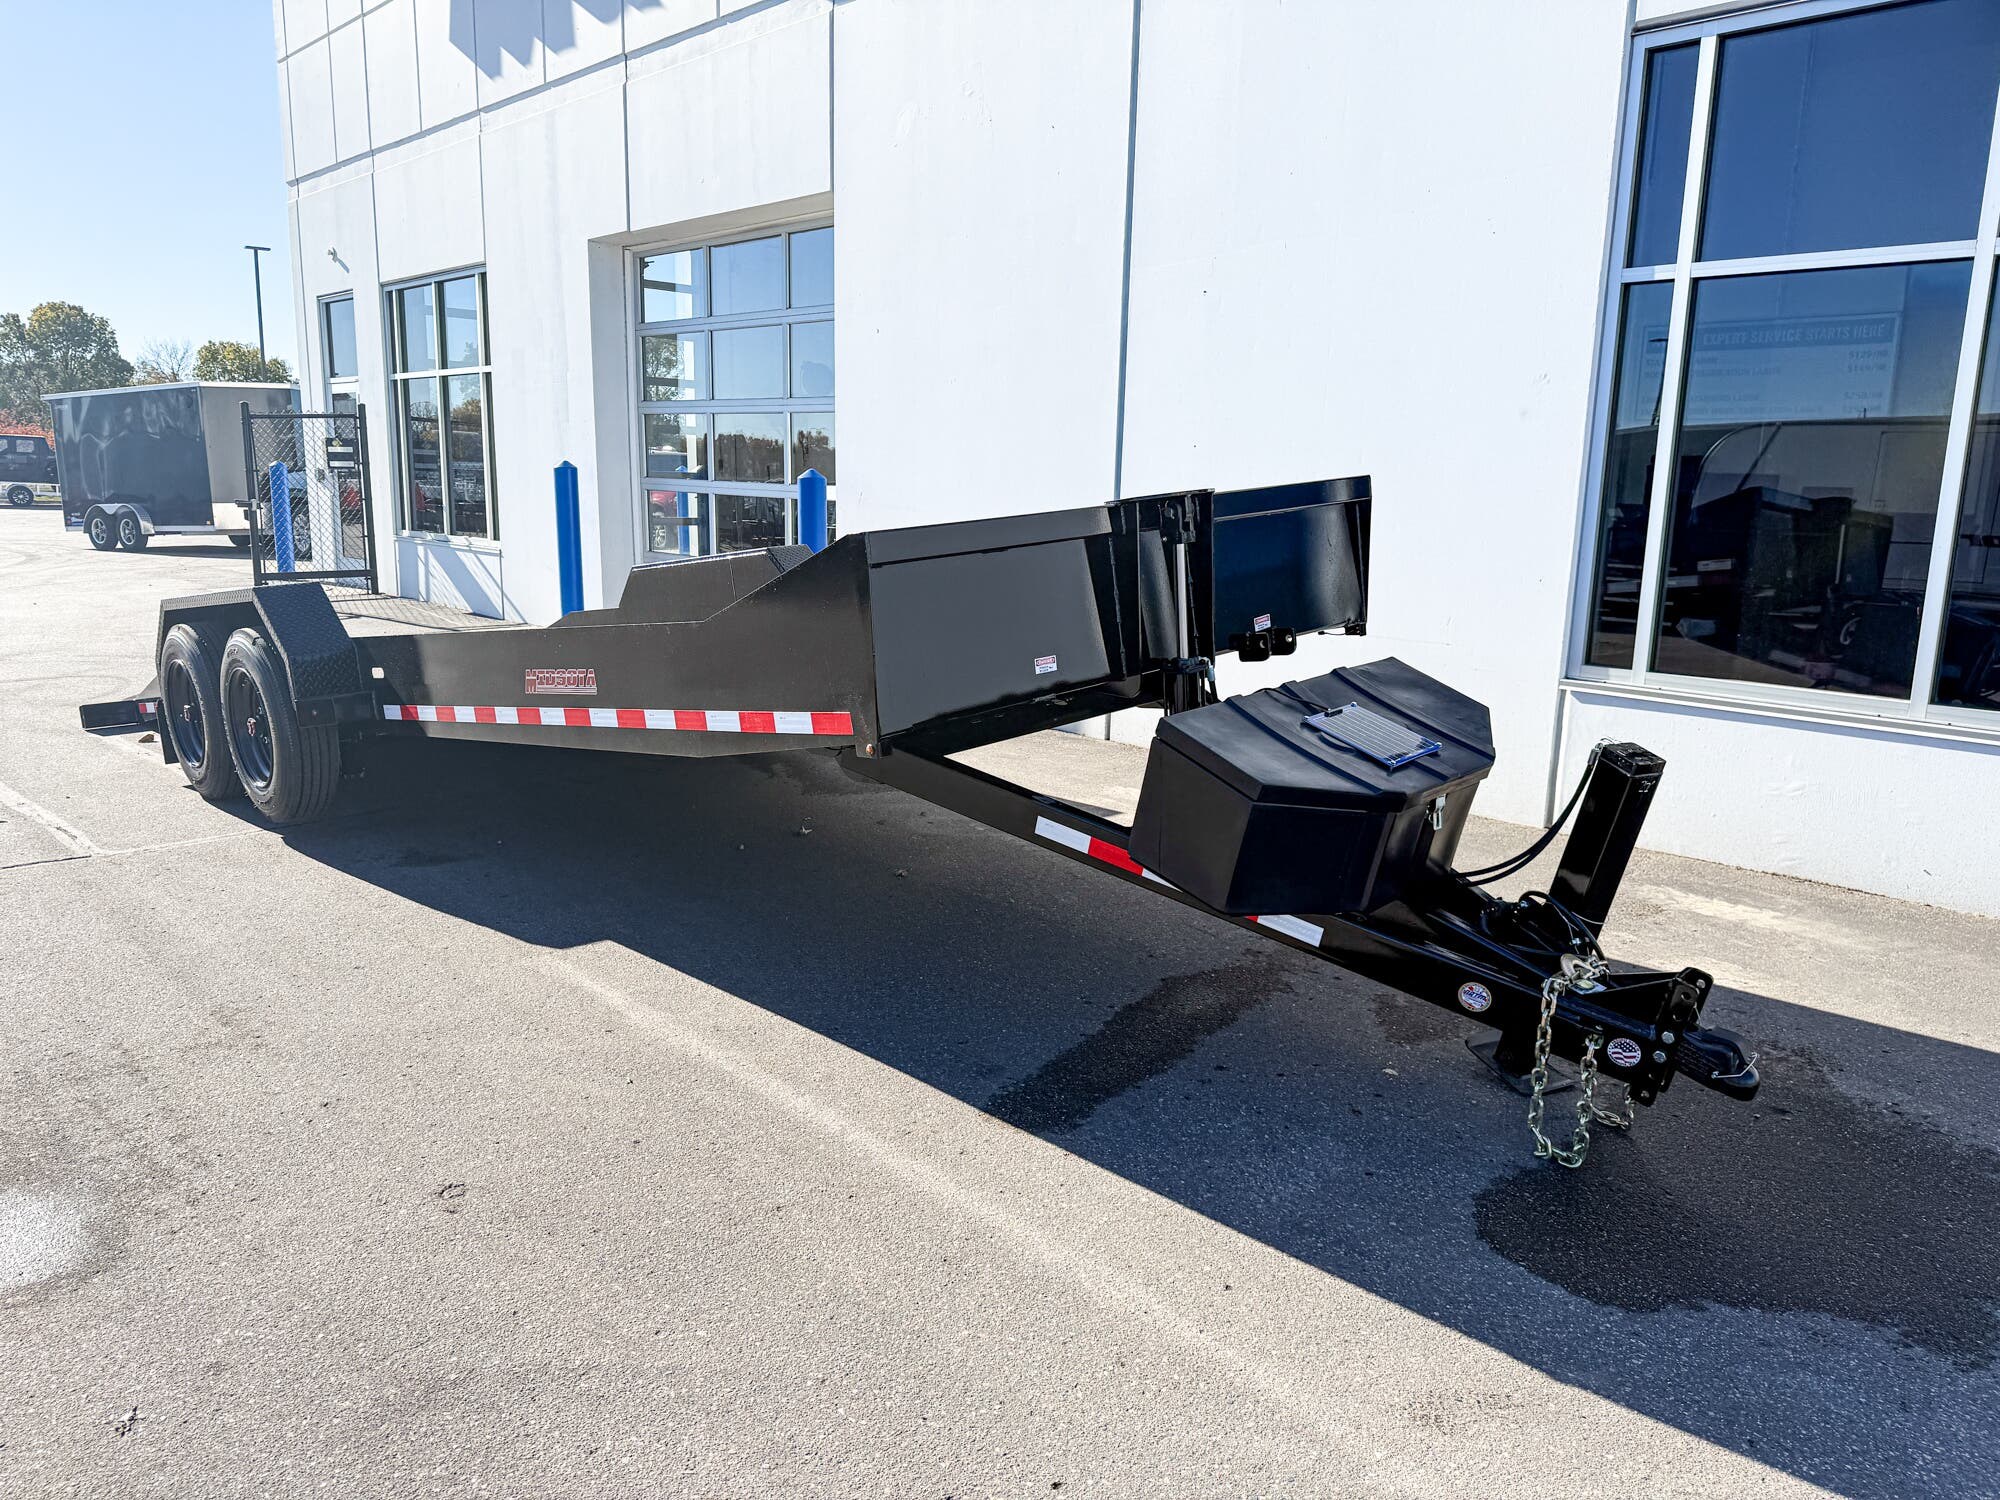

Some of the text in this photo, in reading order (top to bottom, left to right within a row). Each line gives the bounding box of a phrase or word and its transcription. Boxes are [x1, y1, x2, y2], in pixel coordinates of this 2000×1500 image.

[1750, 327, 1803, 344] SERVICE
[1807, 326, 1850, 340] STARTS
[1854, 324, 1885, 338] HERE
[525, 669, 597, 694] MIDSOTA
